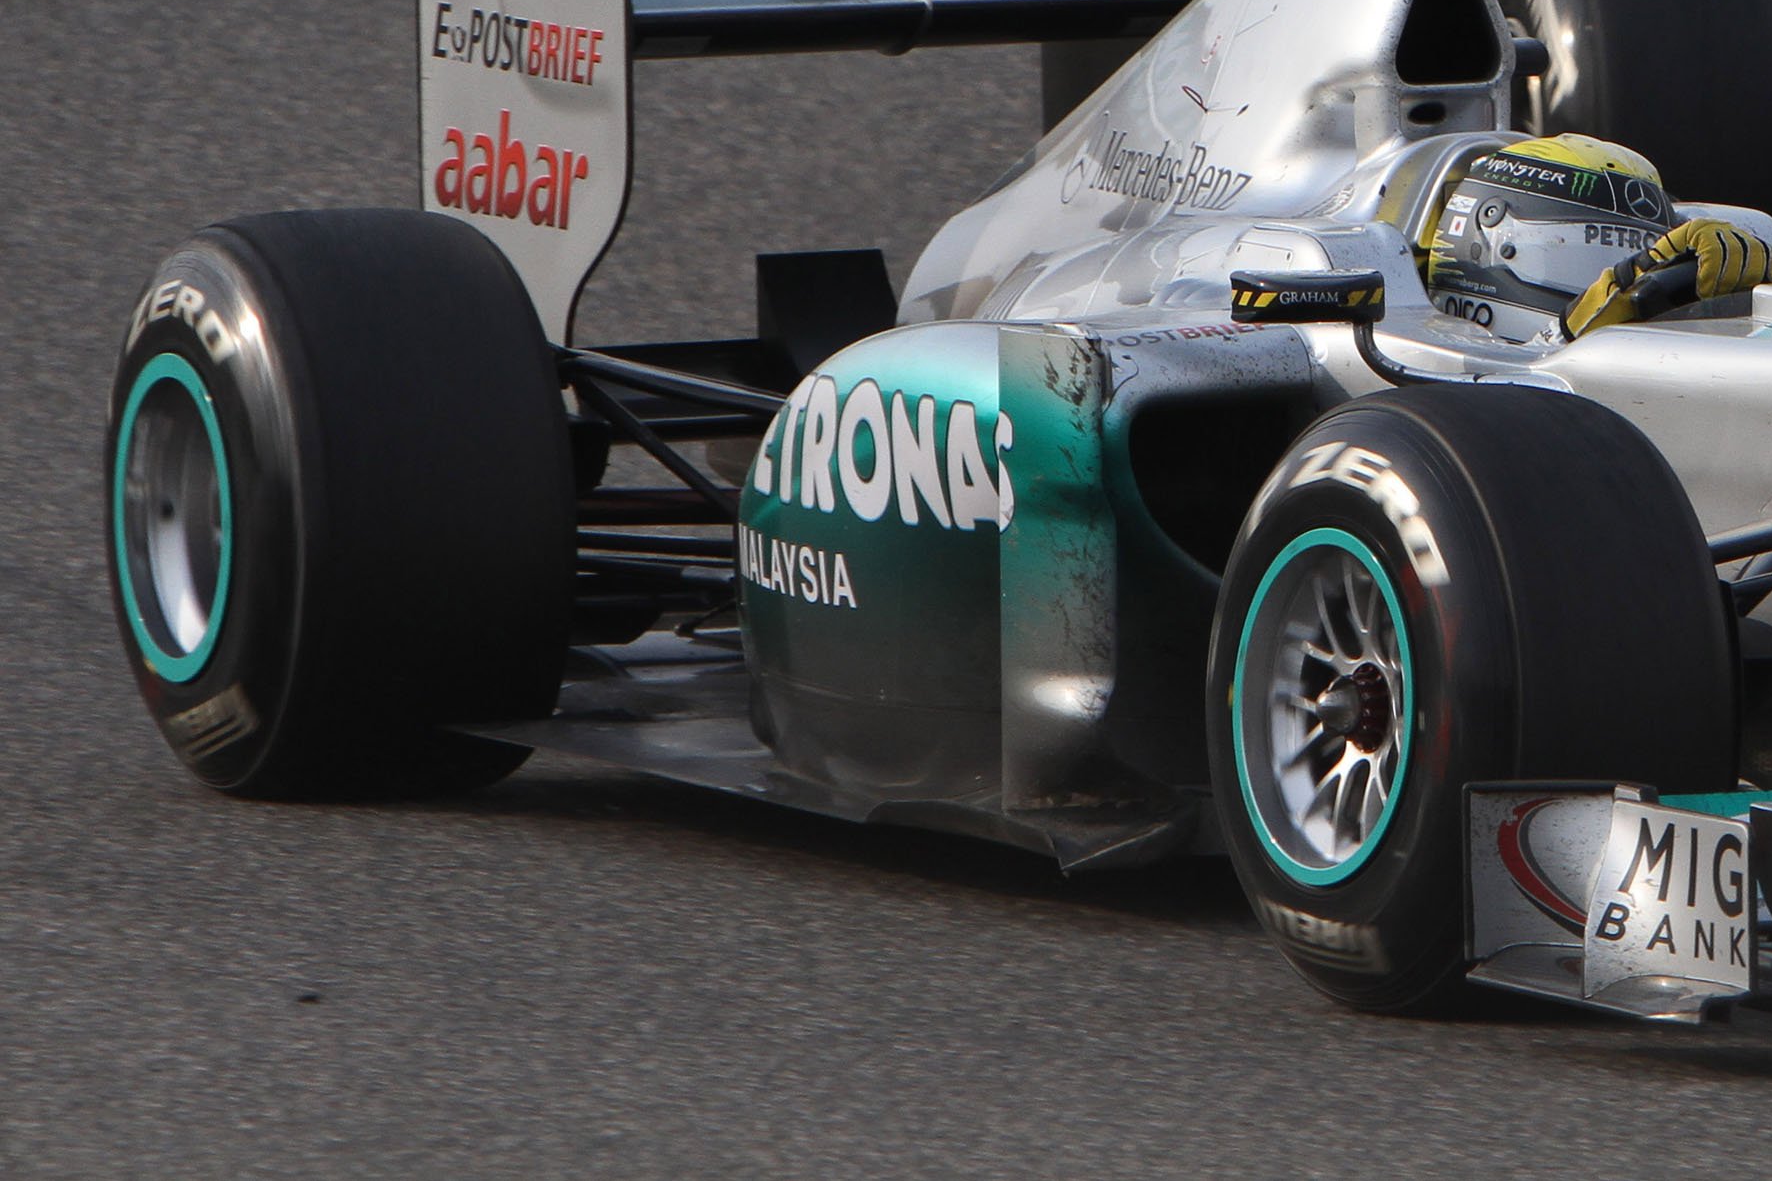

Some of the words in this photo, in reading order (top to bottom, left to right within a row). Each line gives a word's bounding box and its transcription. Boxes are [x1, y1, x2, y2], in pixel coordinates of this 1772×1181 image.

[434, 108, 589, 230] aabar
[1089, 130, 1253, 211] Mercedes-Benz
[1279, 290, 1339, 305] GRAHAM
[1618, 817, 1744, 918] MIG
[1595, 900, 1747, 969] BANK
